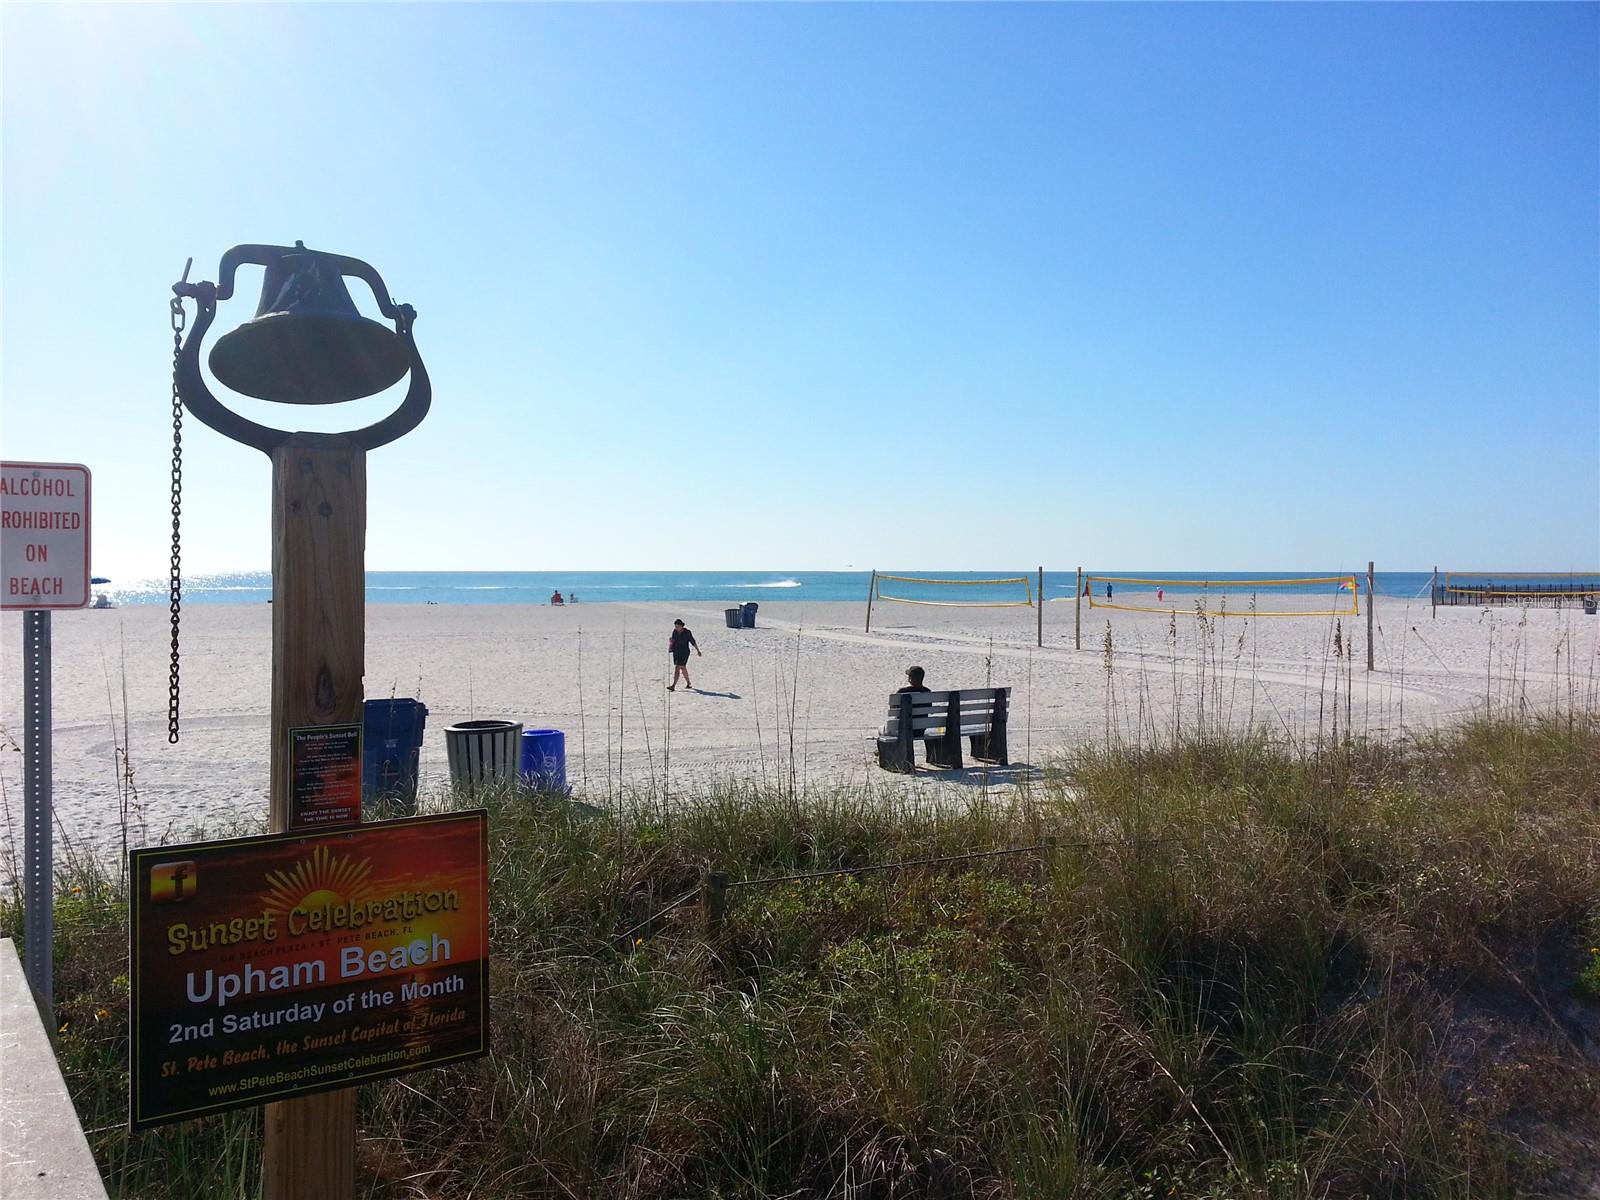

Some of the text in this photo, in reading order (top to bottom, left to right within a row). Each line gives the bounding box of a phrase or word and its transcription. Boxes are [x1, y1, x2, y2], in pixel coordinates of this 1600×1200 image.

[0, 478, 75, 497] ALCOHOL
[1, 511, 80, 529] ROHIBITED
[26, 544, 48, 562] ON
[10, 577, 63, 595] BEACH
[307, 733, 329, 742] People's
[336, 812, 350, 820] NOW
[167, 888, 459, 956] Sunset Celebration
[337, 934, 361, 944] PETE
[186, 933, 452, 1006] Upham Beach
[168, 974, 465, 1044] 2nd Saturday of the Month
[161, 1061, 180, 1078] St.
[186, 1055, 217, 1073] Pete
[276, 1040, 298, 1055] the
[303, 1029, 347, 1051] Sunset
[351, 1019, 400, 1042] Capital
[403, 1017, 416, 1033] of
[419, 1008, 467, 1027] Florida
[208, 1043, 431, 1098] www.StPeteBeachSunsetCelebration.com
